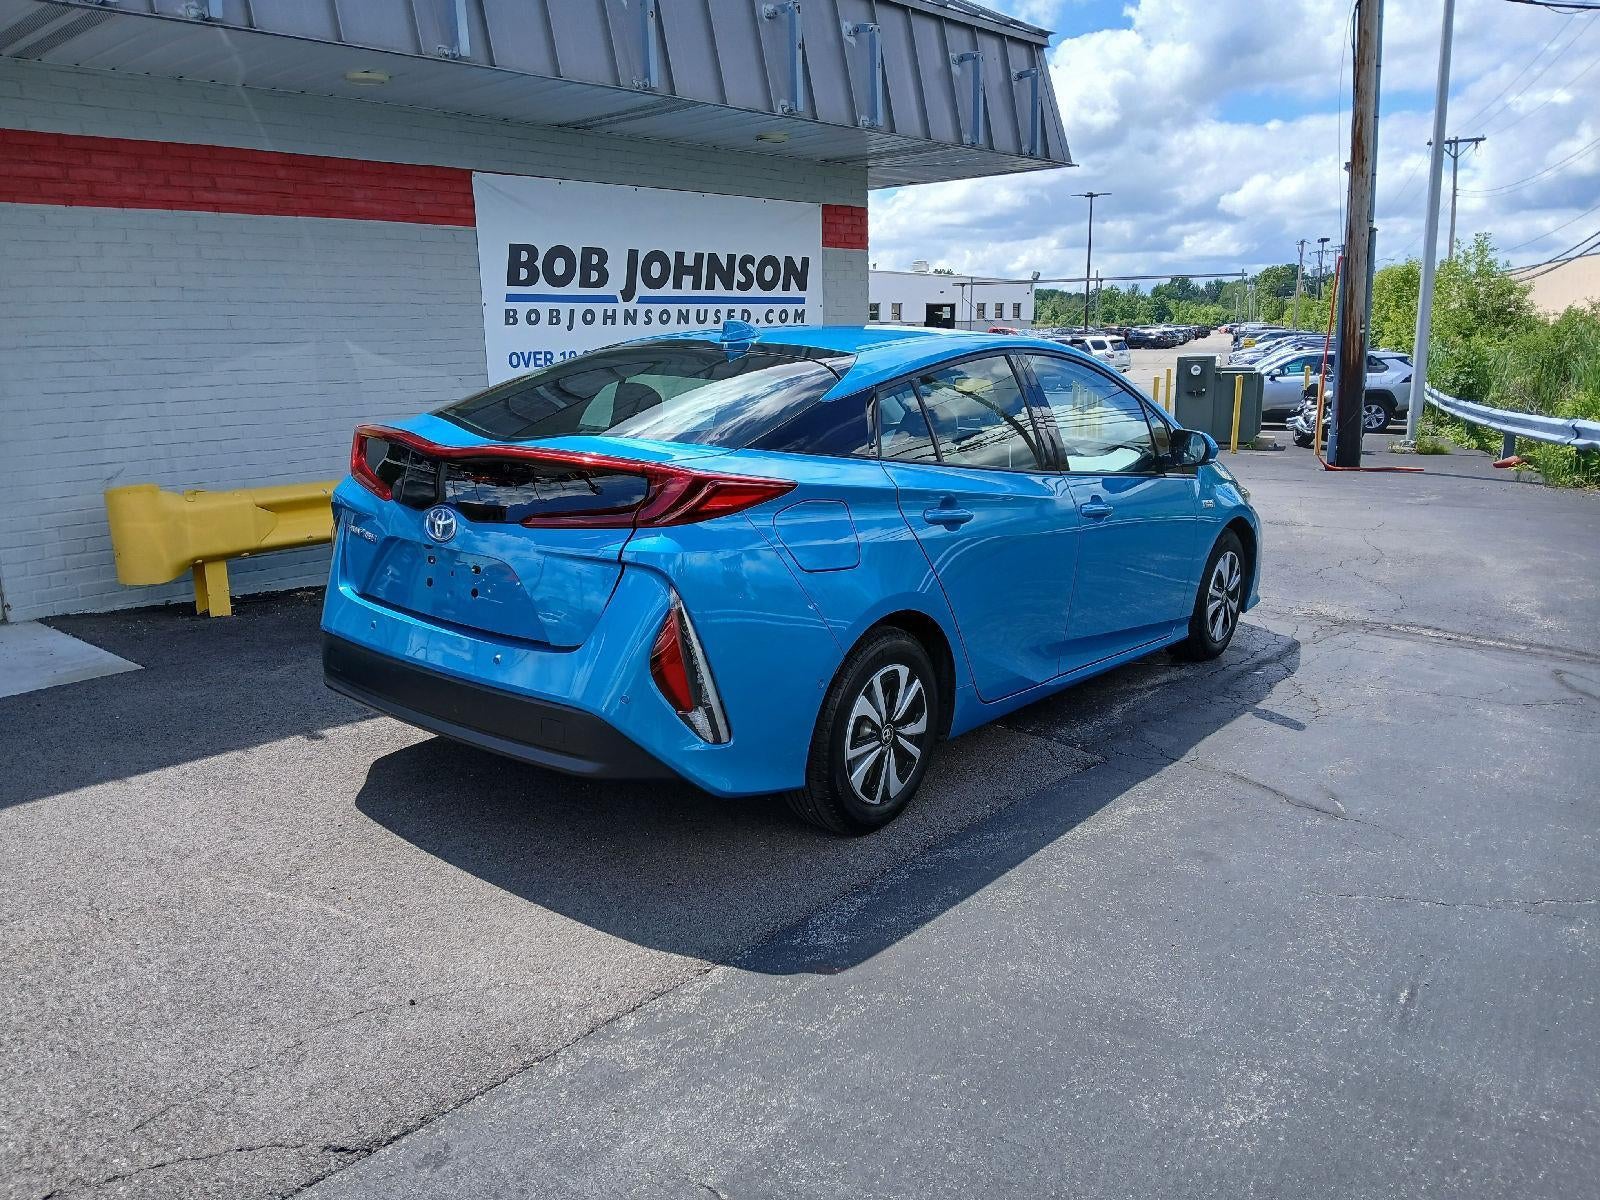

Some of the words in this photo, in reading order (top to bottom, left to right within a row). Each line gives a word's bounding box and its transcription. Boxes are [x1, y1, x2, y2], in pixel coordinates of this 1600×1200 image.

[506, 243, 609, 288] BOB
[620, 249, 809, 302] JOHNSON
[505, 308, 806, 331] BOBJOHNSONUSED.COM
[508, 350, 555, 369] OVER
